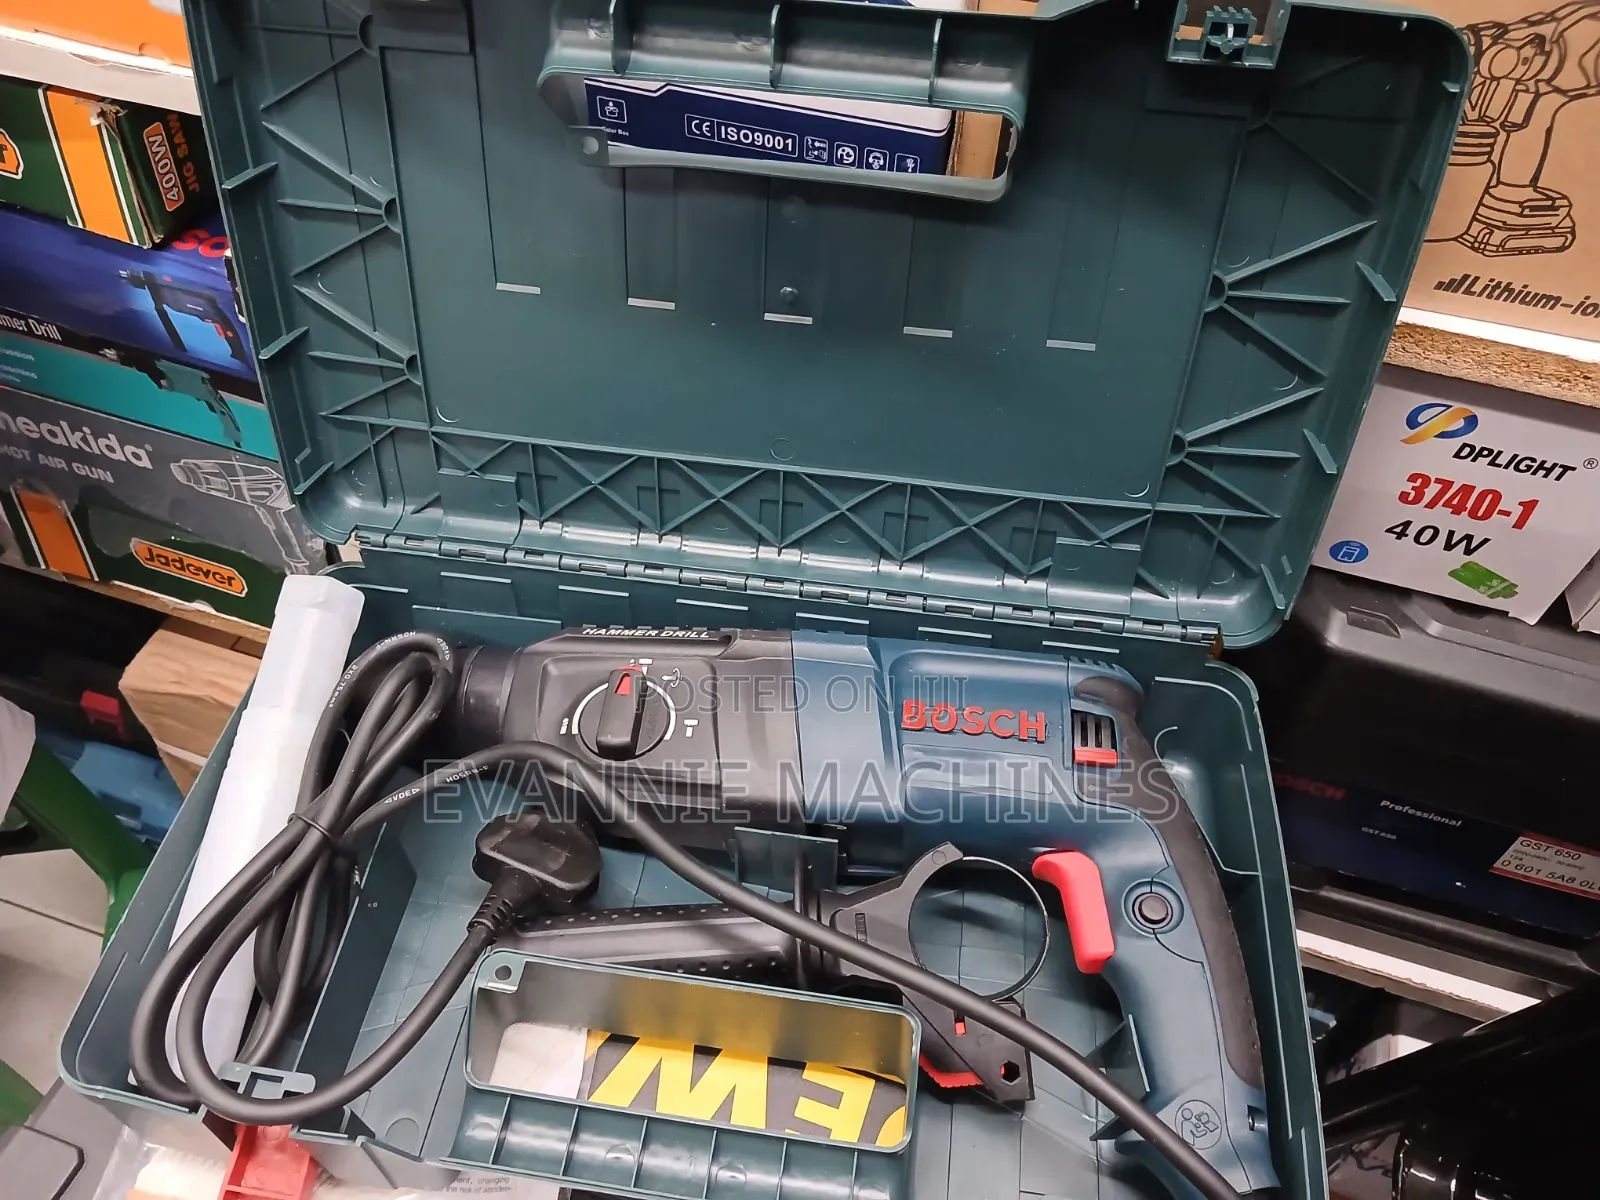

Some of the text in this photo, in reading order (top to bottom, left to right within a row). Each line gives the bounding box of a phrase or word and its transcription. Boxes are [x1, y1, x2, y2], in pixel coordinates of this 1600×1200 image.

[721, 125, 793, 152] ISO9001
[148, 134, 179, 201] 400W
[183, 161, 200, 192] JIG
[1461, 275, 1600, 319] Lithium-io
[0, 315, 62, 341] mer Drill
[38, 453, 69, 471] AIR
[72, 462, 114, 484] GUN
[1452, 442, 1577, 483] DPLIGHT
[1398, 472, 1539, 530] 3740-1
[1384, 519, 1492, 557] 40W
[144, 547, 236, 587] Jadever
[582, 628, 710, 638] HAMMER DRILL
[901, 699, 1049, 743] BOSCH
[1380, 800, 1462, 827] Professional
[1520, 839, 1554, 853] GST
[1554, 848, 1581, 860] 650
[1514, 863, 1542, 875] 601
[1546, 871, 1577, 884] 5A8
